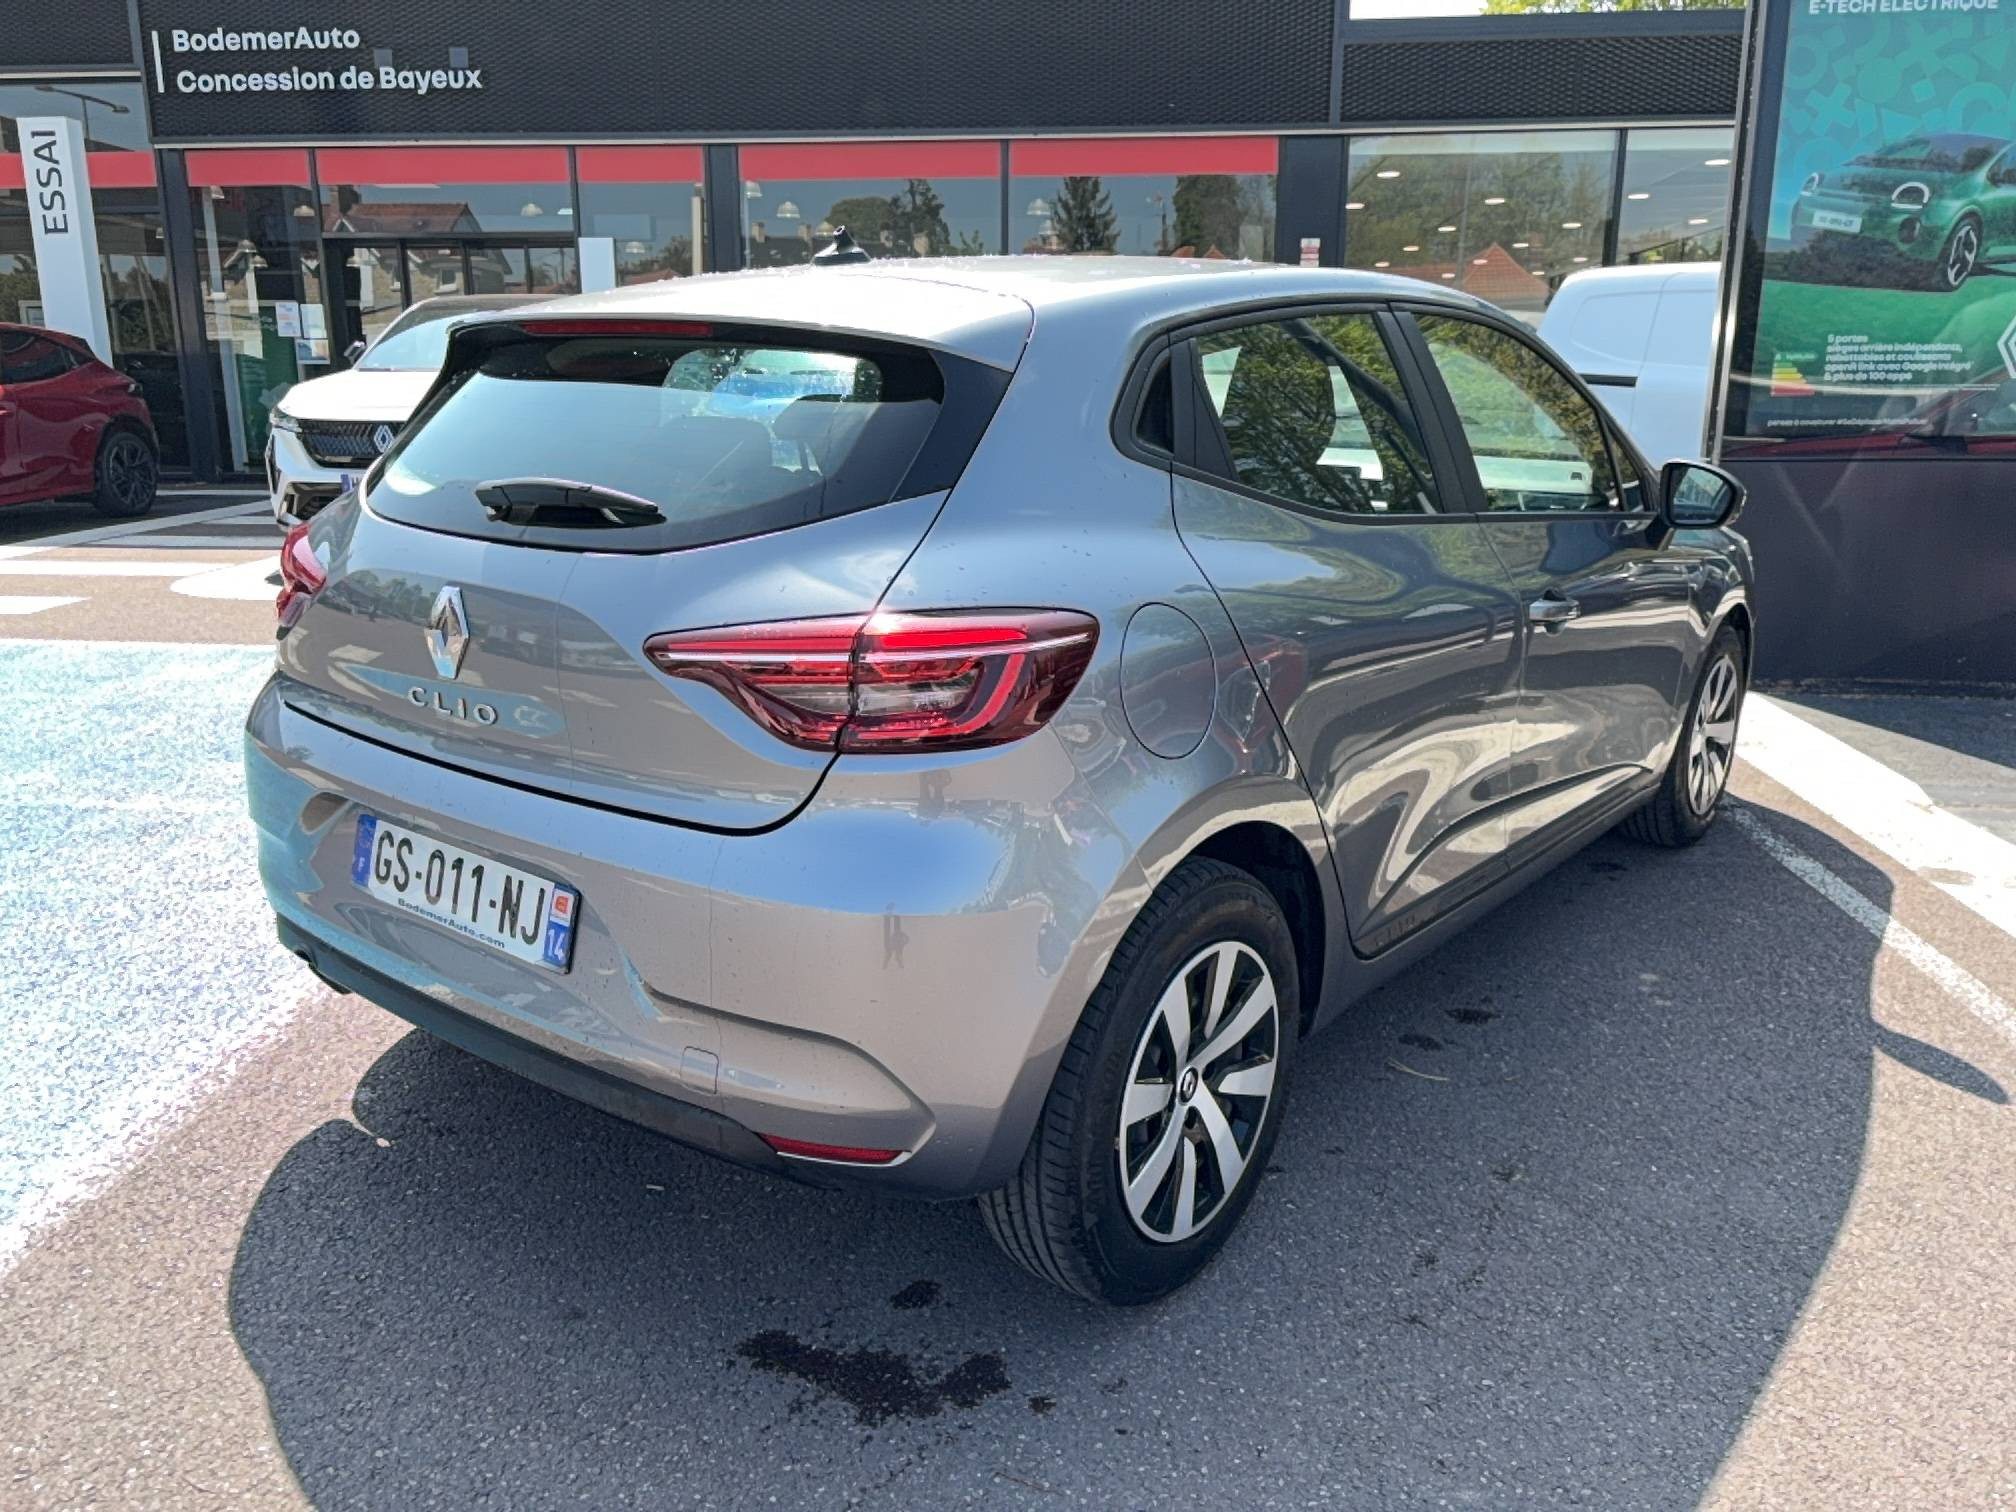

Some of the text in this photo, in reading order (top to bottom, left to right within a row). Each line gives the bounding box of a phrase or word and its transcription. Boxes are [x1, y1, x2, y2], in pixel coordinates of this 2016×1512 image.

[172, 27, 360, 51] BodemerAuto
[177, 66, 482, 95] Concession de Bayeux
[31, 130, 68, 235] ESSAI
[408, 686, 498, 725] CLIO
[375, 830, 545, 945] GS-011-NJ
[397, 897, 506, 949] BodemerAuto.com
[548, 928, 566, 962] 14
